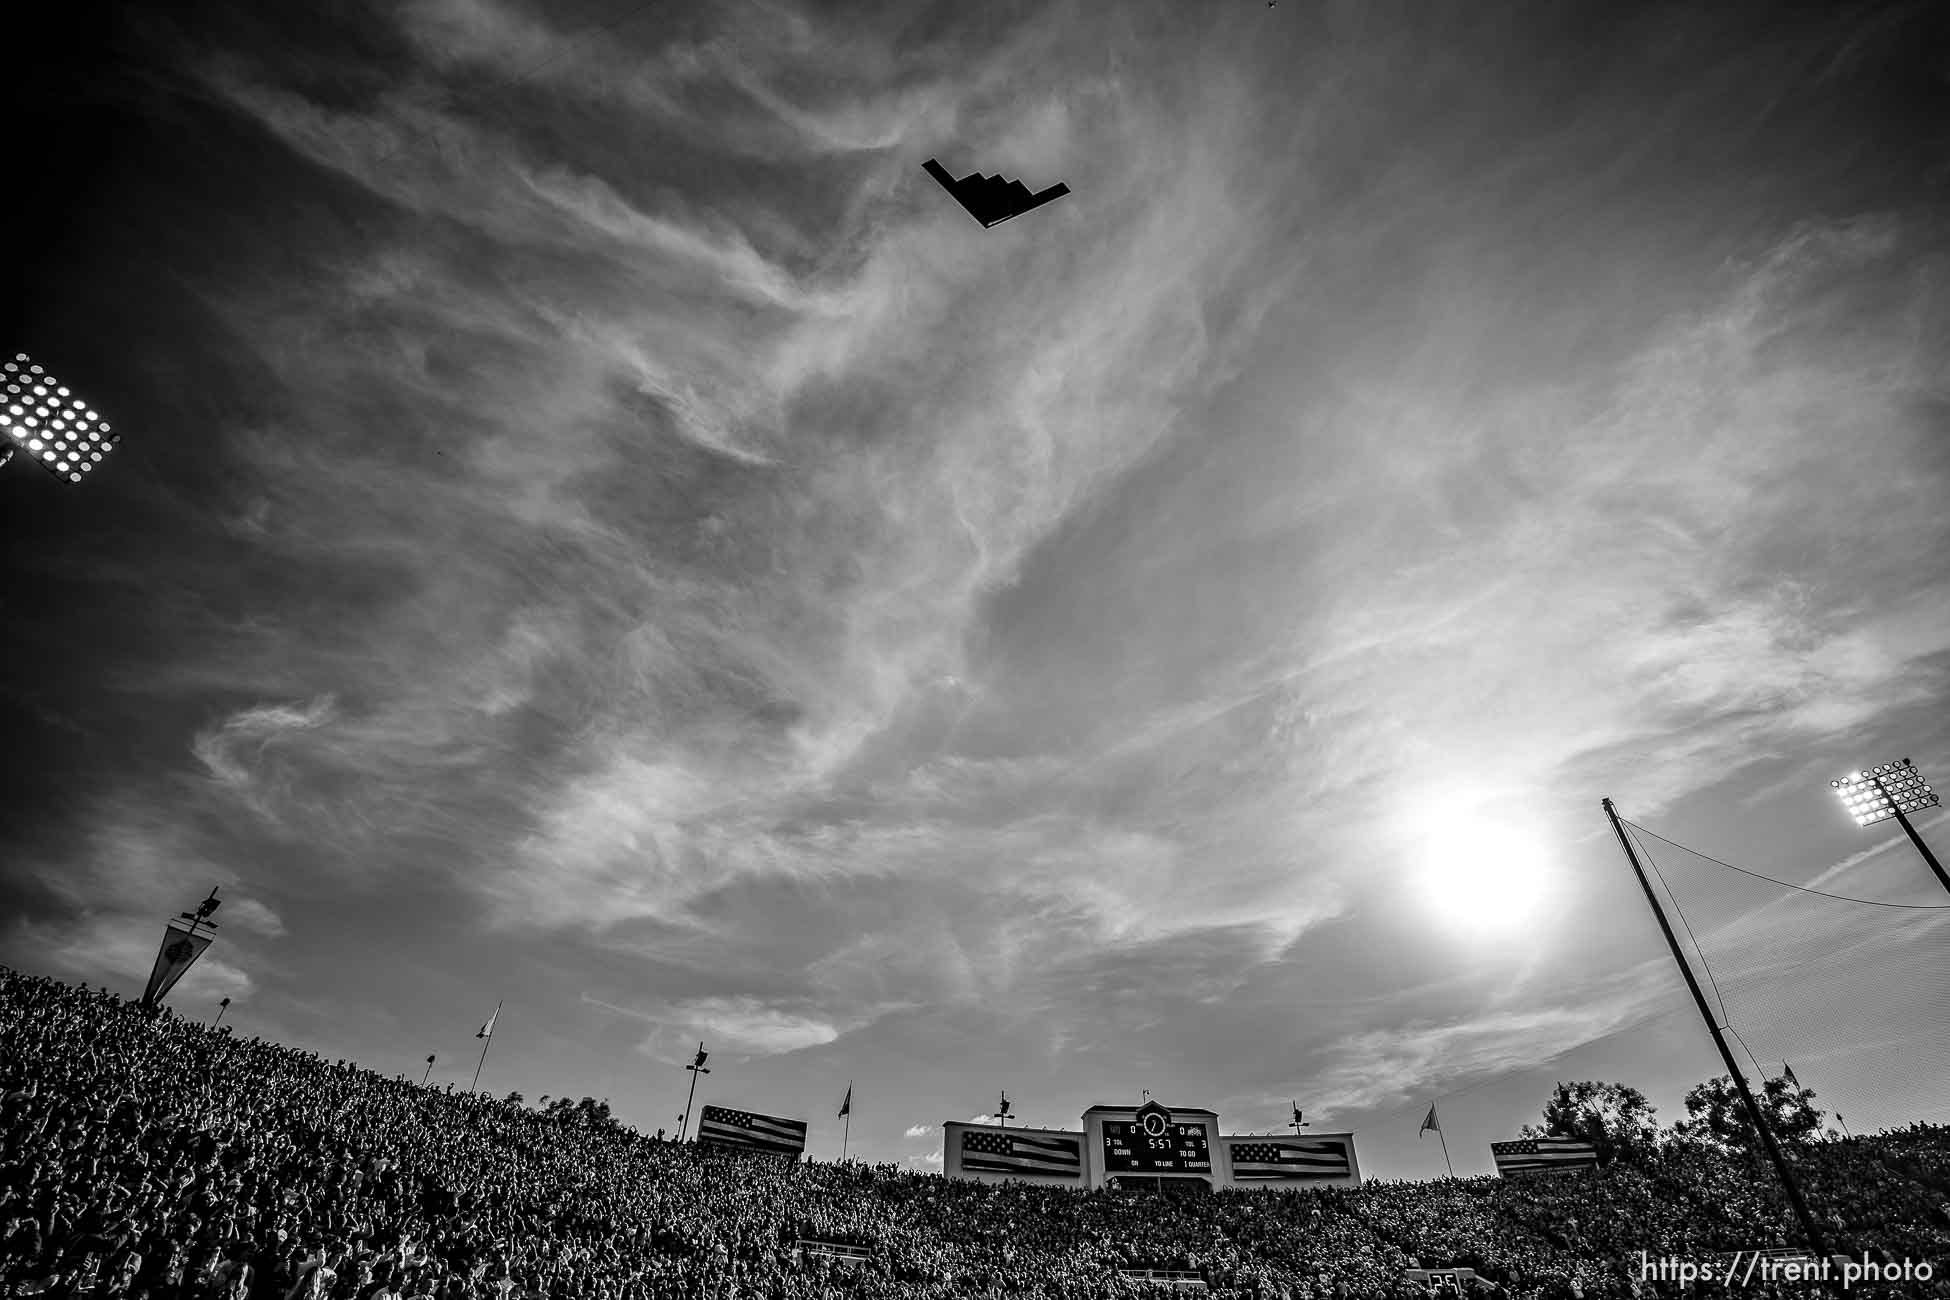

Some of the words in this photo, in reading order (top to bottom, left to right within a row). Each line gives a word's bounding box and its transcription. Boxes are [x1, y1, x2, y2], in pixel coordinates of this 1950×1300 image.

[1130, 1125, 1136, 1134] 0
[1179, 1126, 1185, 1136] 0
[1148, 1138, 1172, 1149] 5:57
[1201, 1139, 1207, 1149] 3
[1114, 1148, 1131, 1156] DOWN
